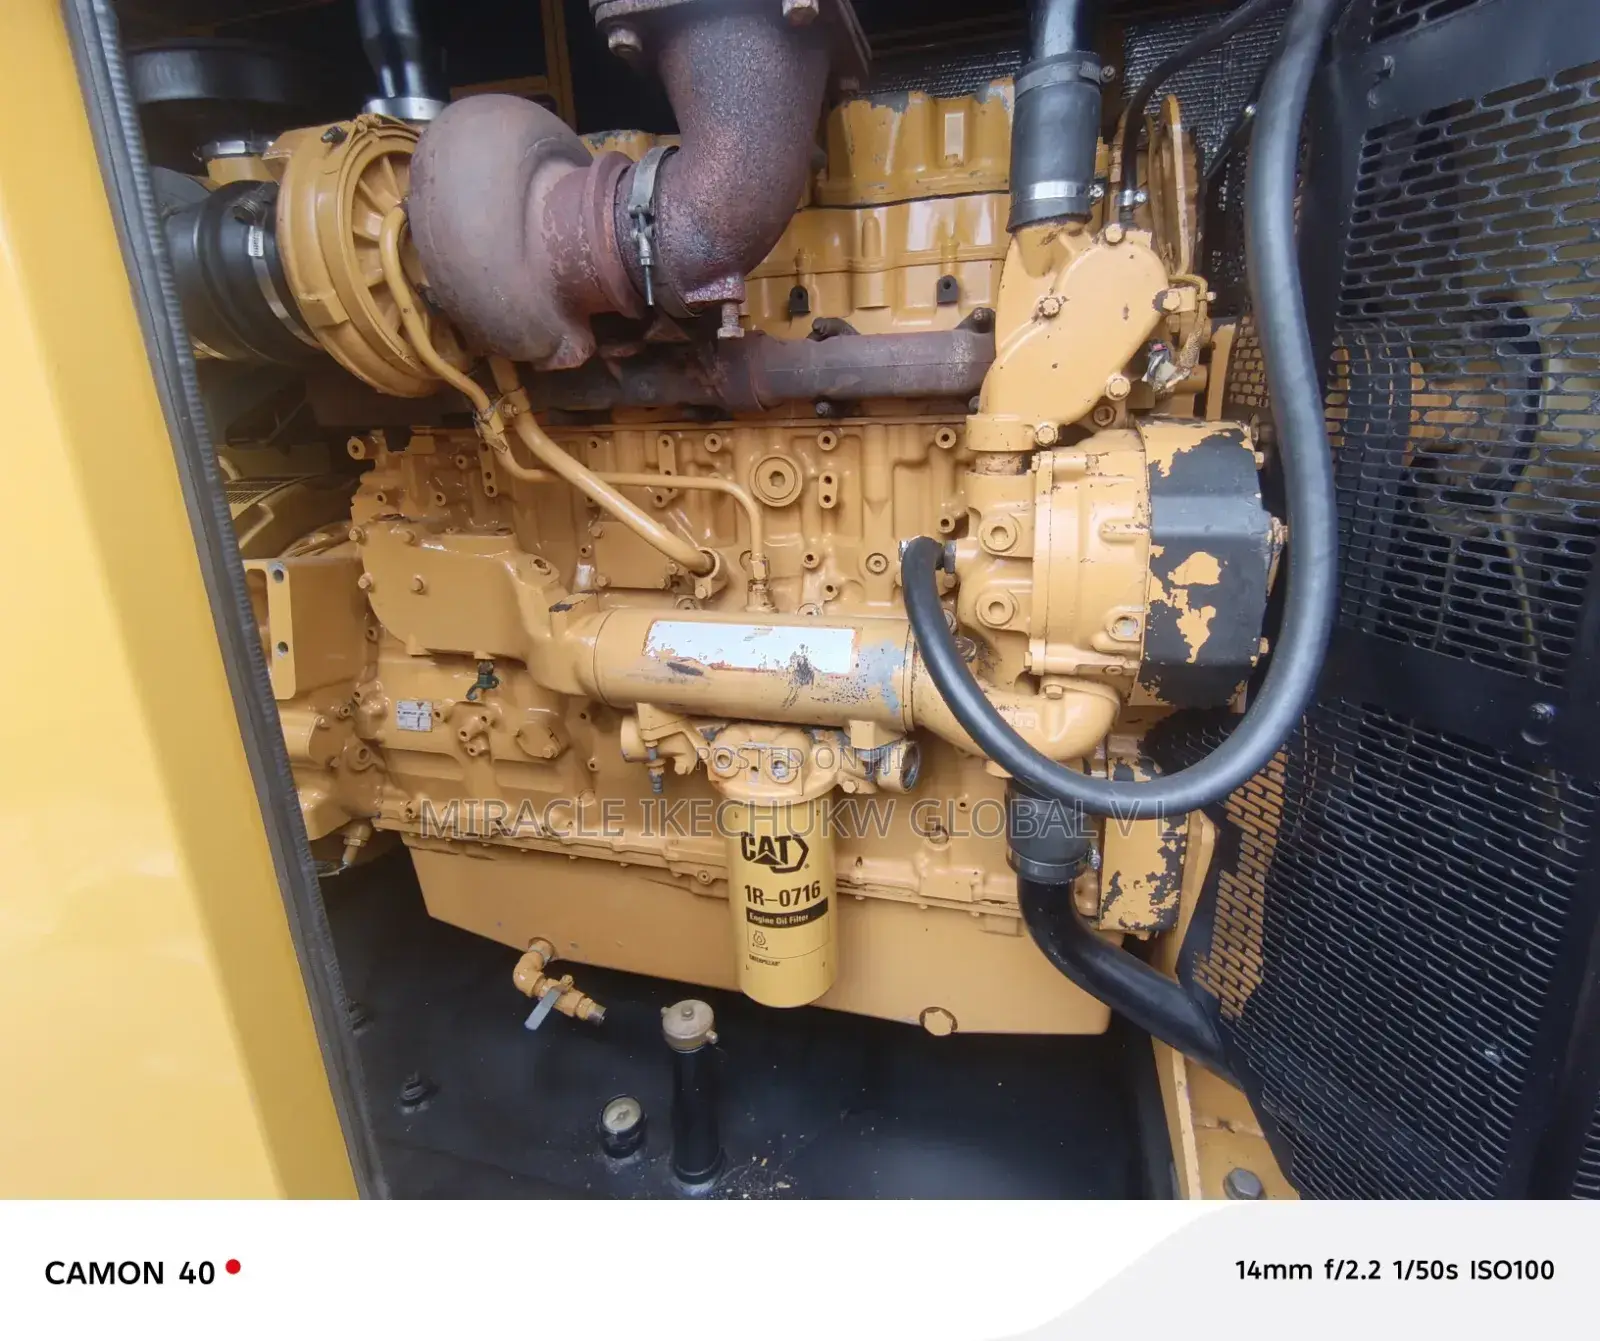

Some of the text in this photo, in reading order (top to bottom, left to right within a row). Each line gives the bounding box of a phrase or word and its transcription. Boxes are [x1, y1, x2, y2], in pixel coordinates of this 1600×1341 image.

[740, 831, 804, 870] CAT
[749, 912, 809, 925] Engine Oil Filter
